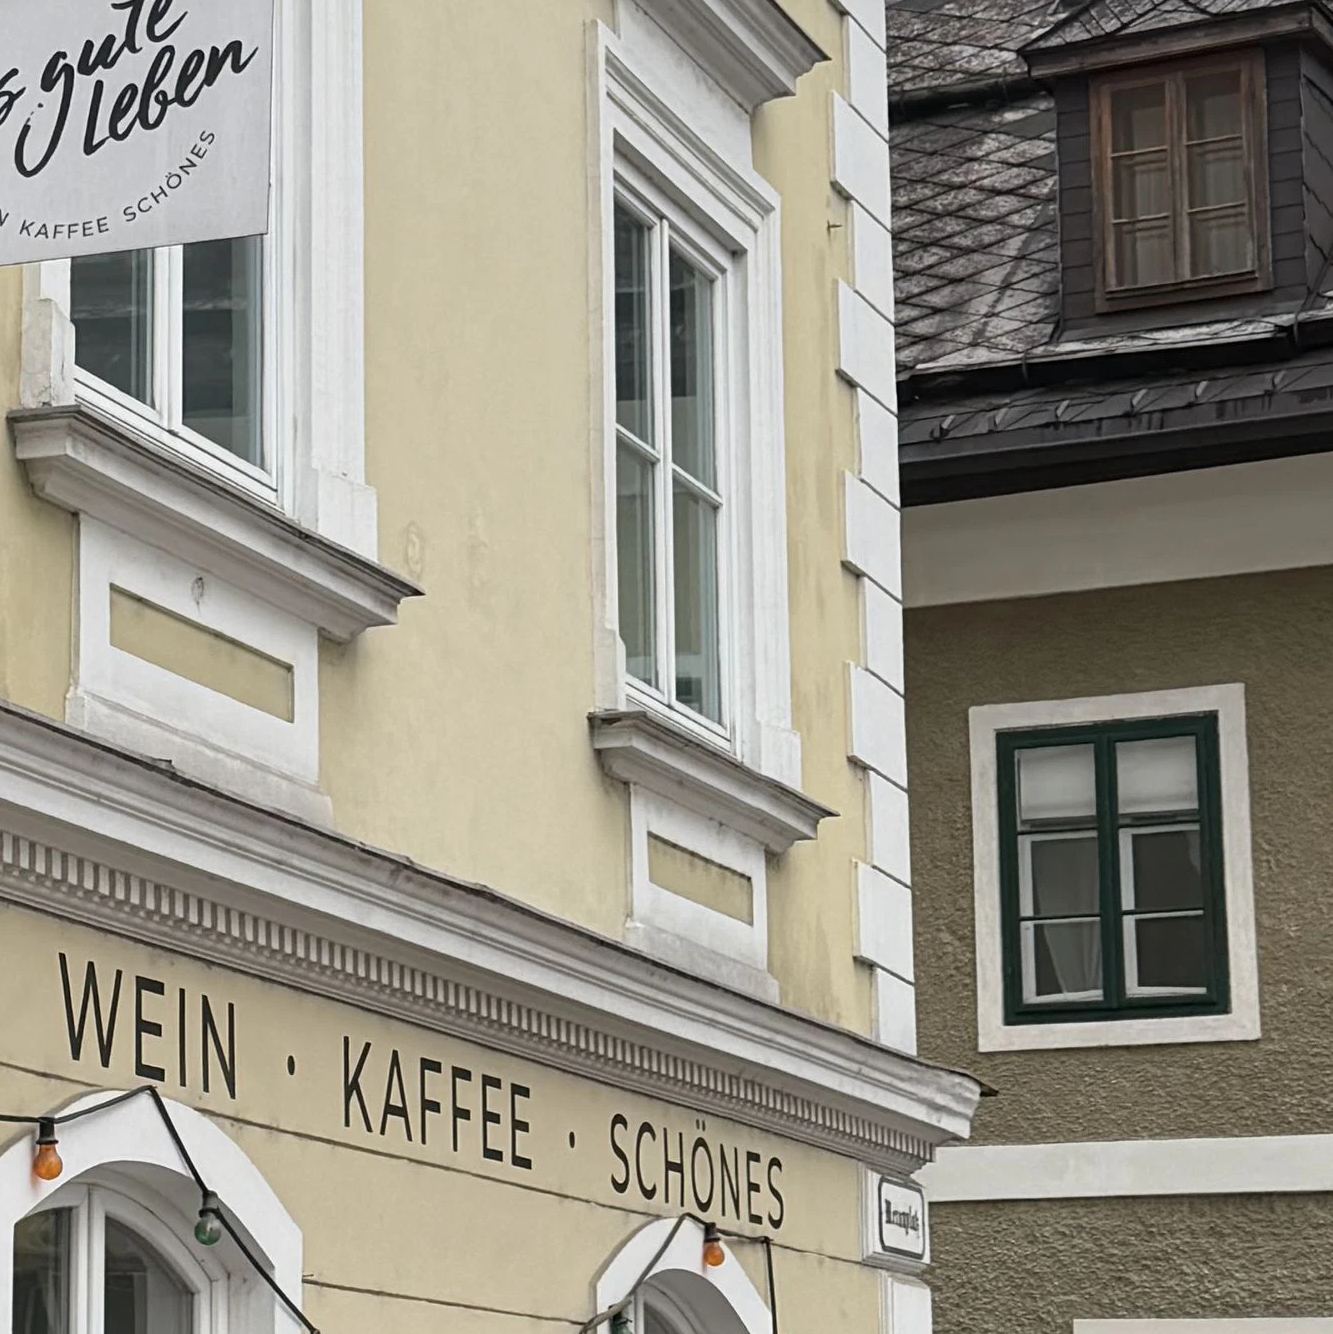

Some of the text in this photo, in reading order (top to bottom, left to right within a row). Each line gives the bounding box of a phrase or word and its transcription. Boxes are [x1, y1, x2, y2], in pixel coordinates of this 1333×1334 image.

[19, 216, 111, 241] KAFFEE
[122, 127, 217, 223] SCHÖNES
[57, 951, 786, 1230] WEIN KAFFEE SCHÖNES
